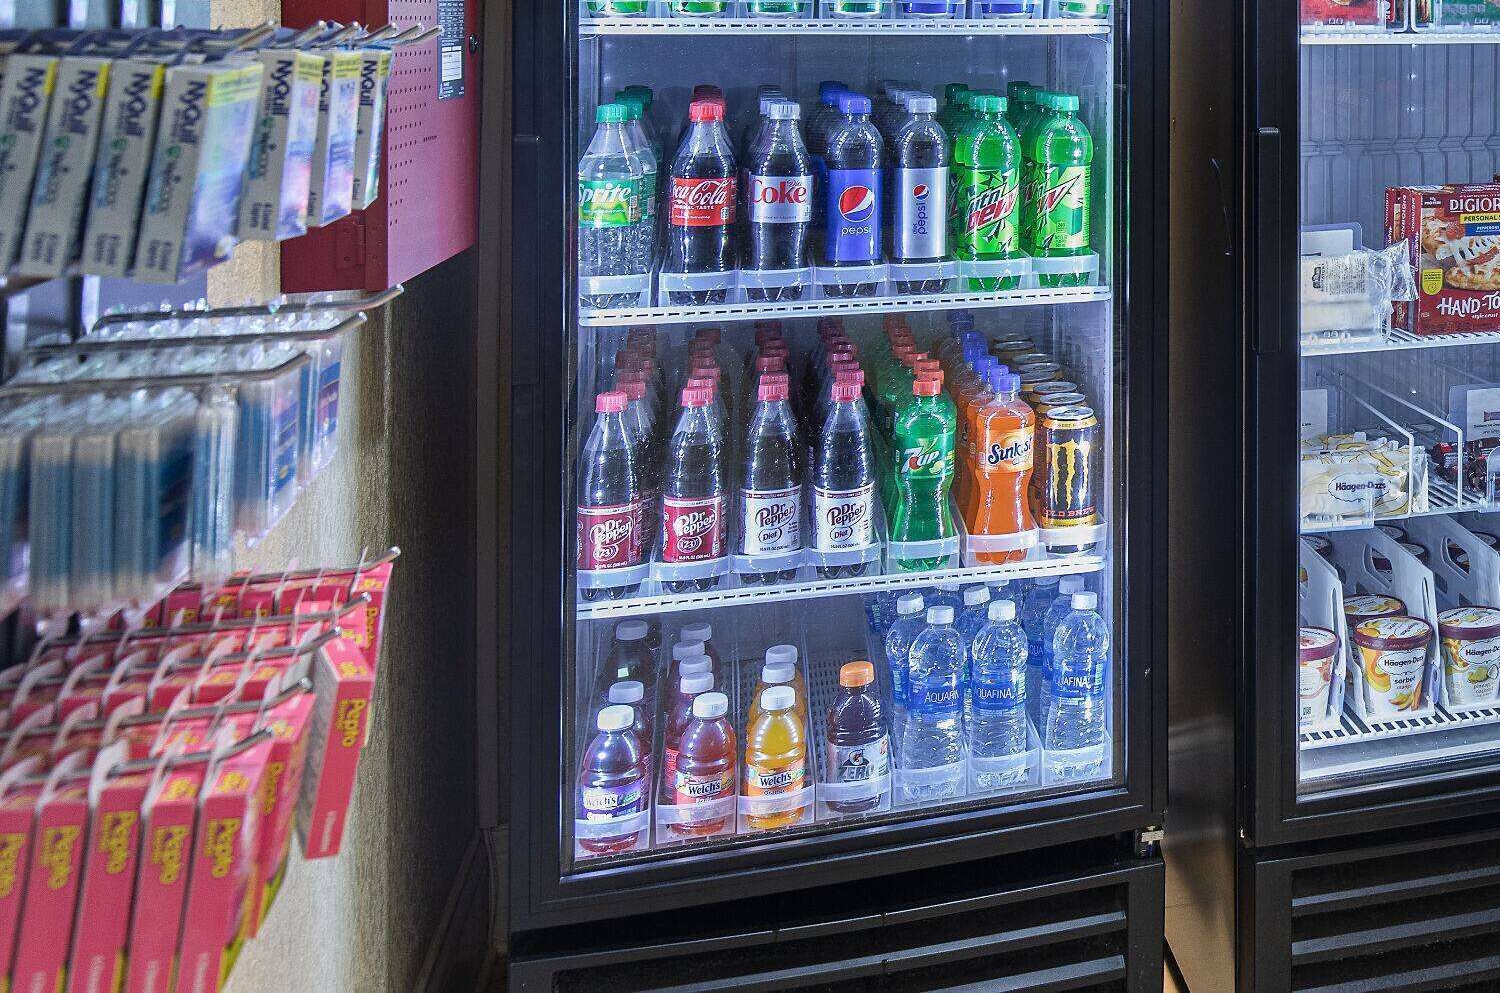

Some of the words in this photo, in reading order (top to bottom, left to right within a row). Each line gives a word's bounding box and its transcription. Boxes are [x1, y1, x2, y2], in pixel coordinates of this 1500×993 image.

[271, 58, 293, 117] NyQuil
[359, 59, 378, 108] NyQuil
[69, 68, 97, 135] NyQuil
[125, 72, 151, 137] NyQuil
[180, 79, 207, 145] NyQuil
[753, 179, 807, 204] Coke
[917, 201, 929, 236] pepsi
[841, 224, 872, 237] pepsi
[988, 435, 1033, 464] Sunkst
[689, 511, 706, 525] Dr
[758, 505, 796, 528] Pepper
[771, 503, 785, 515] Dr
[829, 506, 866, 527] Pepper
[841, 502, 856, 514] Dr
[591, 521, 632, 546] Pepper
[605, 518, 622, 533] Dr
[674, 515, 716, 537] Pepper
[762, 531, 778, 542] Diet
[833, 530, 850, 540] Diet
[344, 697, 369, 749] Pepto
[688, 781, 721, 796] Welch's
[760, 773, 792, 787] Welch's
